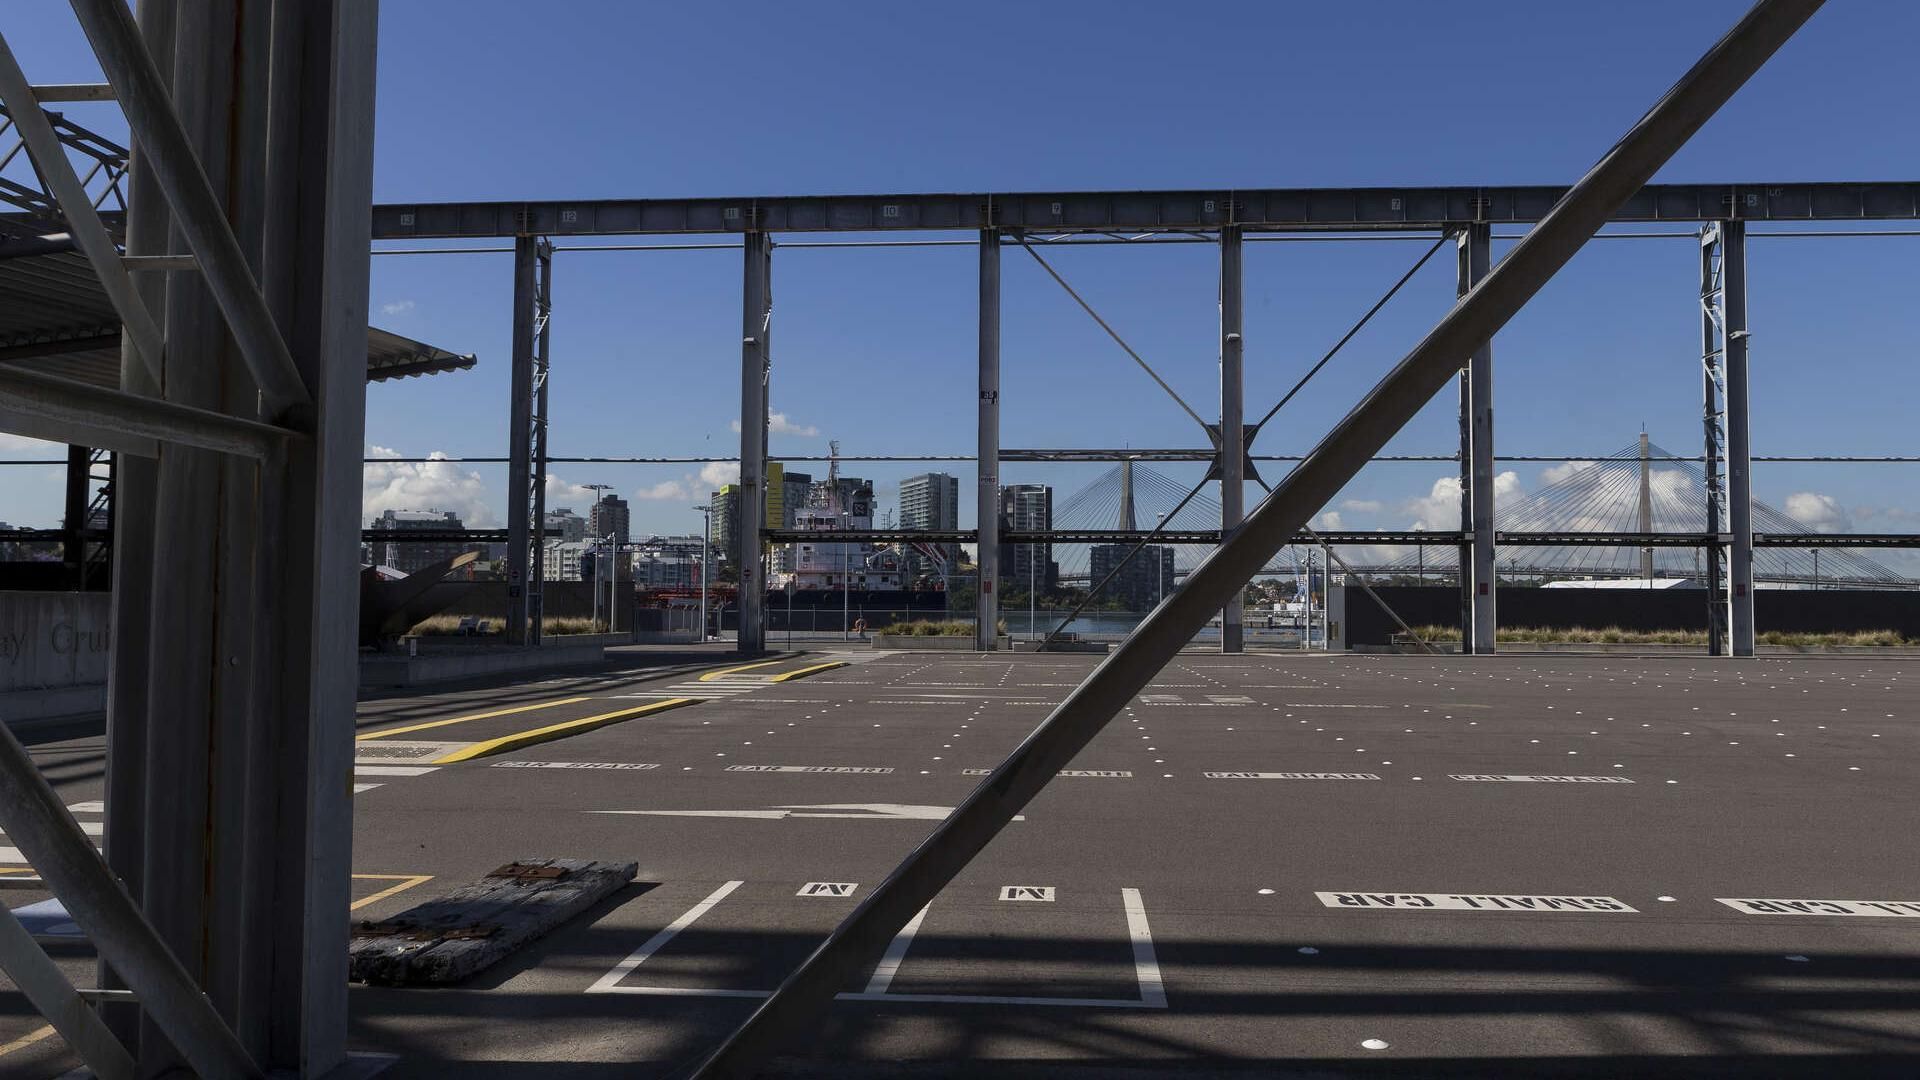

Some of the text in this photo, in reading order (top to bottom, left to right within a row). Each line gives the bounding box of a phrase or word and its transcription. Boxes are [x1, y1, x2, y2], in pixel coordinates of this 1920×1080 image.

[726, 208, 737, 218] 11
[885, 206, 897, 216] 10
[401, 215, 413, 225] 13
[564, 212, 576, 221] 12
[1452, 774, 1628, 783] CAR SHARE
[1333, 893, 1623, 910] SMALL CAR
[1737, 900, 1855, 914] CAR
